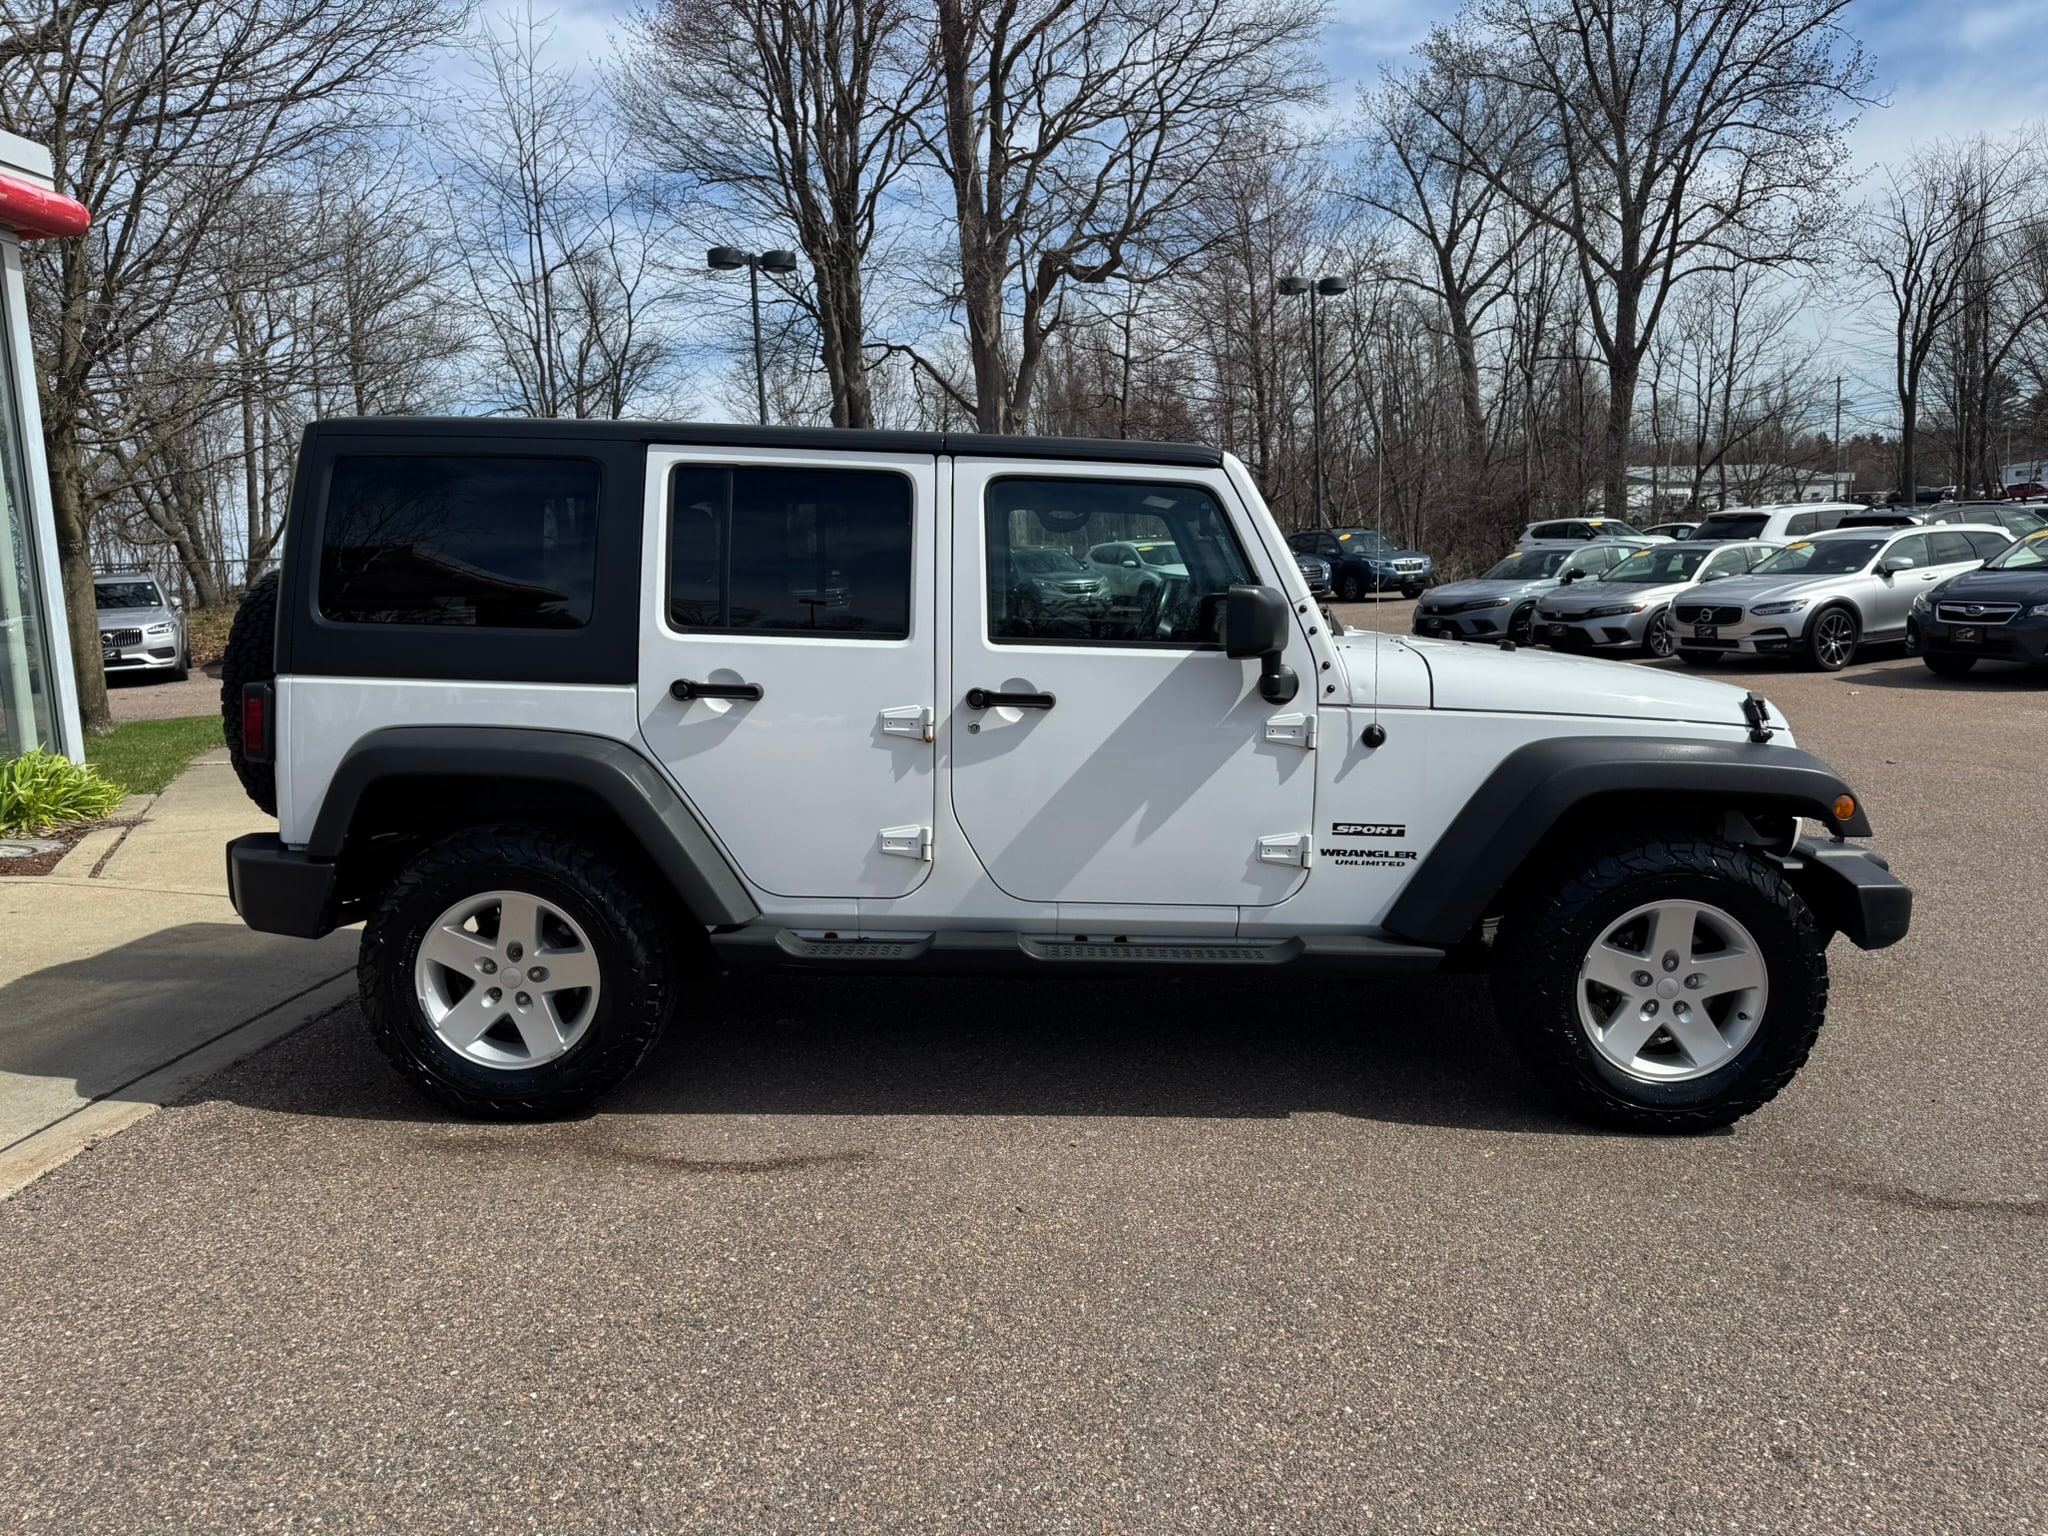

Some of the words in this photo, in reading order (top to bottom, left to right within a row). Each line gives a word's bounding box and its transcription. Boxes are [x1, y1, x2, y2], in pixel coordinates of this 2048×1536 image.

[1333, 824, 1405, 835] SPORT
[1320, 848, 1417, 860] WRANGLER
[1335, 859, 1405, 867] UNLIMITED
